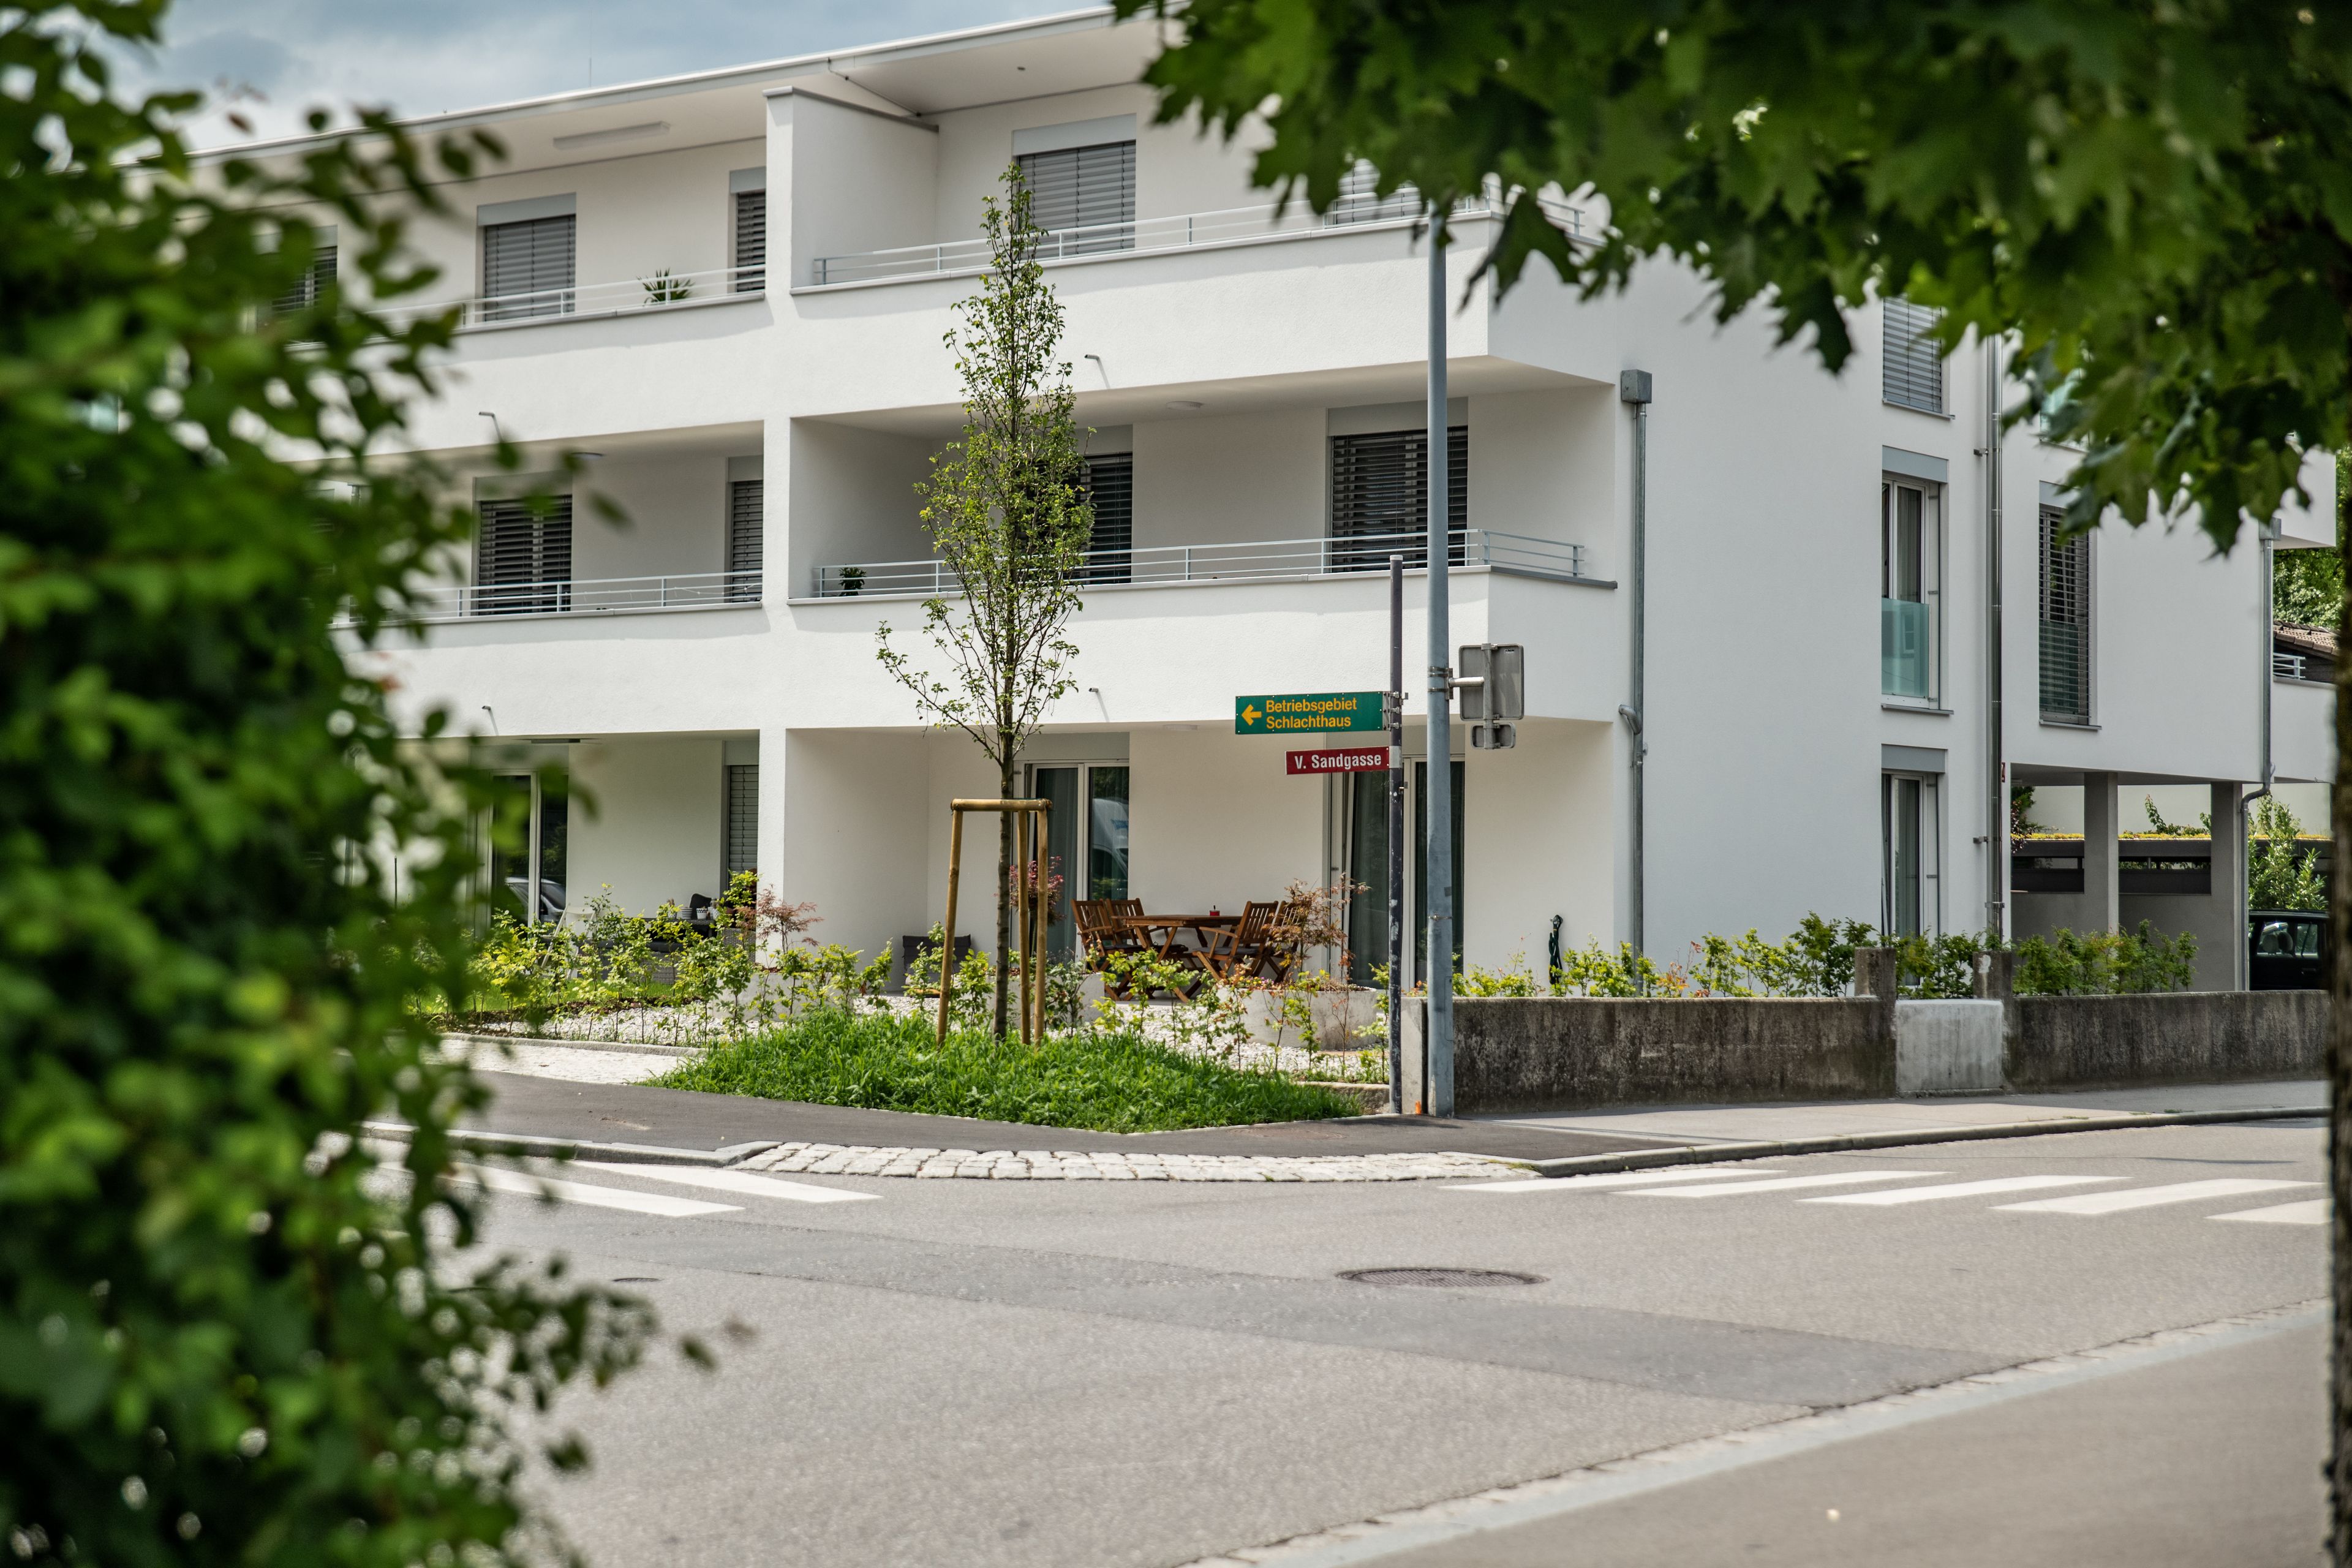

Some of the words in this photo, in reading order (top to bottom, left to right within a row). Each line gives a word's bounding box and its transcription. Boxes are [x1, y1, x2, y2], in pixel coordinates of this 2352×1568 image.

[1266, 698, 1357, 714] Betriebsgebiet
[1266, 715, 1351, 729] Schlachthaus
[1294, 755, 1306, 769] V.
[1311, 753, 1382, 770] Sandgasse
